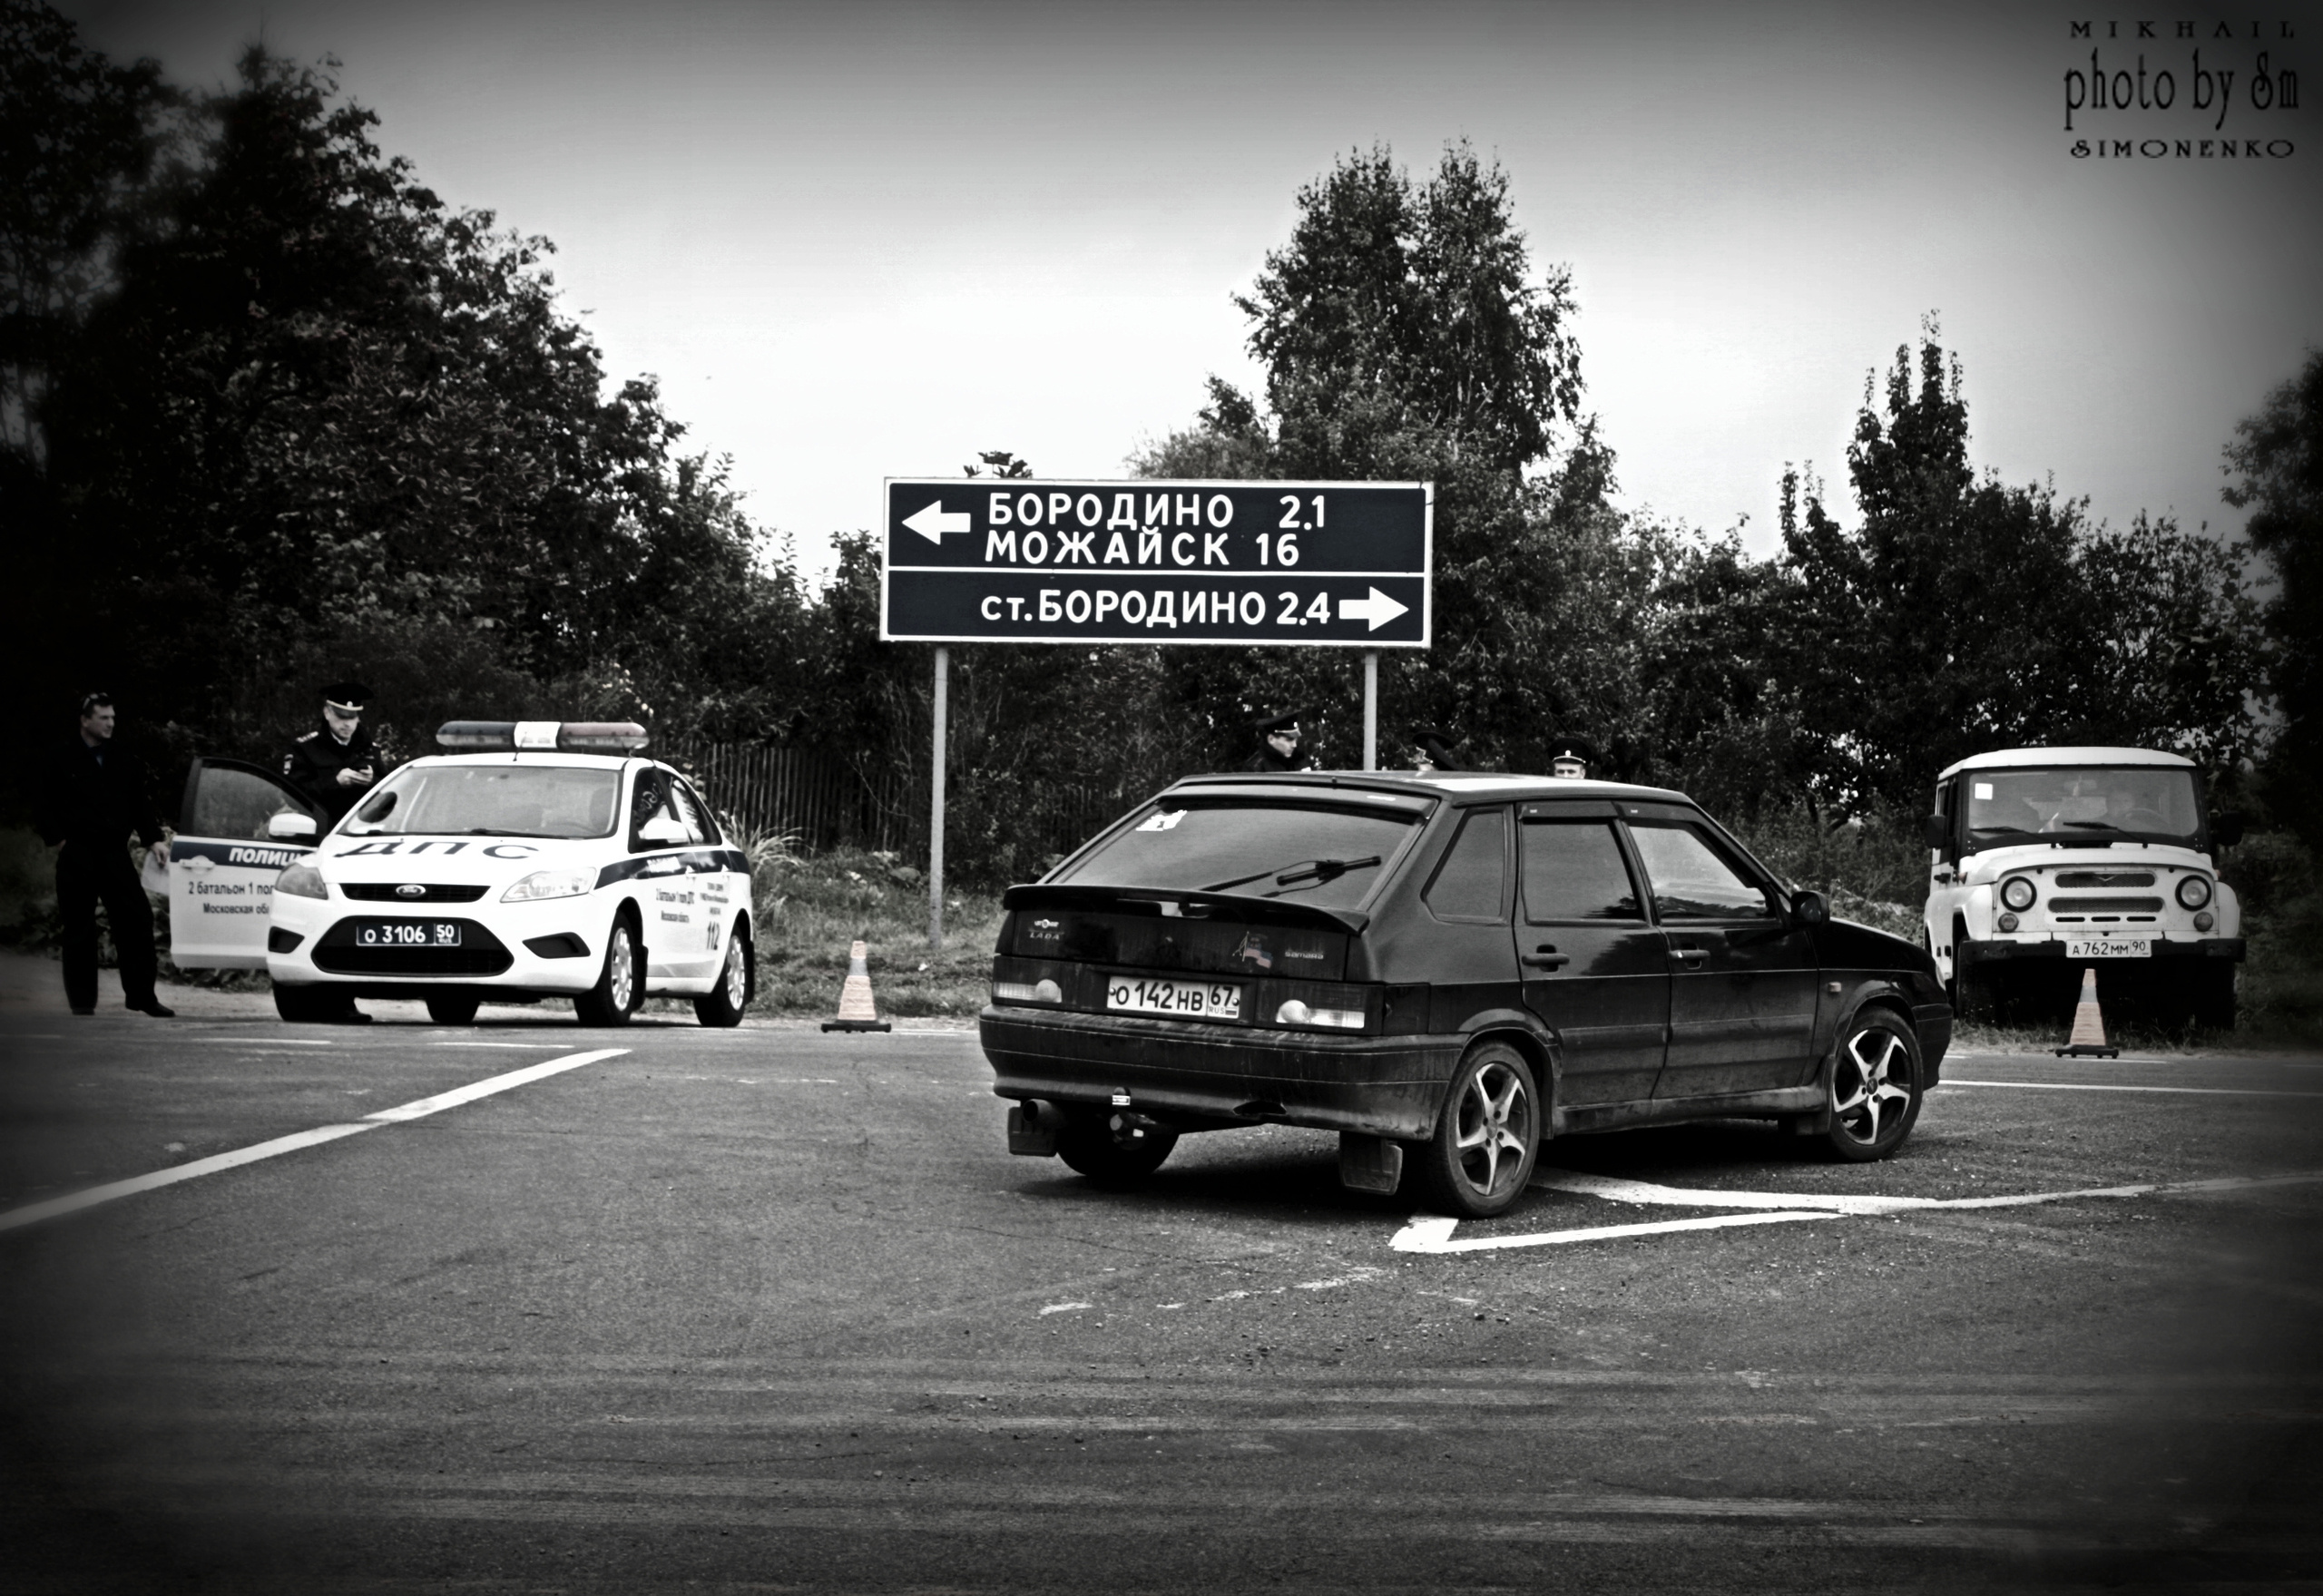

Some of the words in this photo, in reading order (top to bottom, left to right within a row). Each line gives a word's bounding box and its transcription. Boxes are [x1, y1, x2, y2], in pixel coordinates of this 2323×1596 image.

[989, 493, 1234, 531] БОРОДИНО
[1279, 494, 1325, 531] 2.1
[985, 526, 1230, 565] МОЖАЙСК
[1255, 533, 1299, 566] 16
[1277, 592, 1331, 626] 2.4
[229, 847, 300, 867] ПОЛИЦ
[333, 841, 539, 859] ДПС
[189, 881, 194, 895] 2
[197, 881, 245, 895] батальон
[249, 881, 253, 895] 1
[436, 924, 454, 938] 50
[2132, 941, 2146, 951] 90
[1211, 984, 1233, 1006] 67
